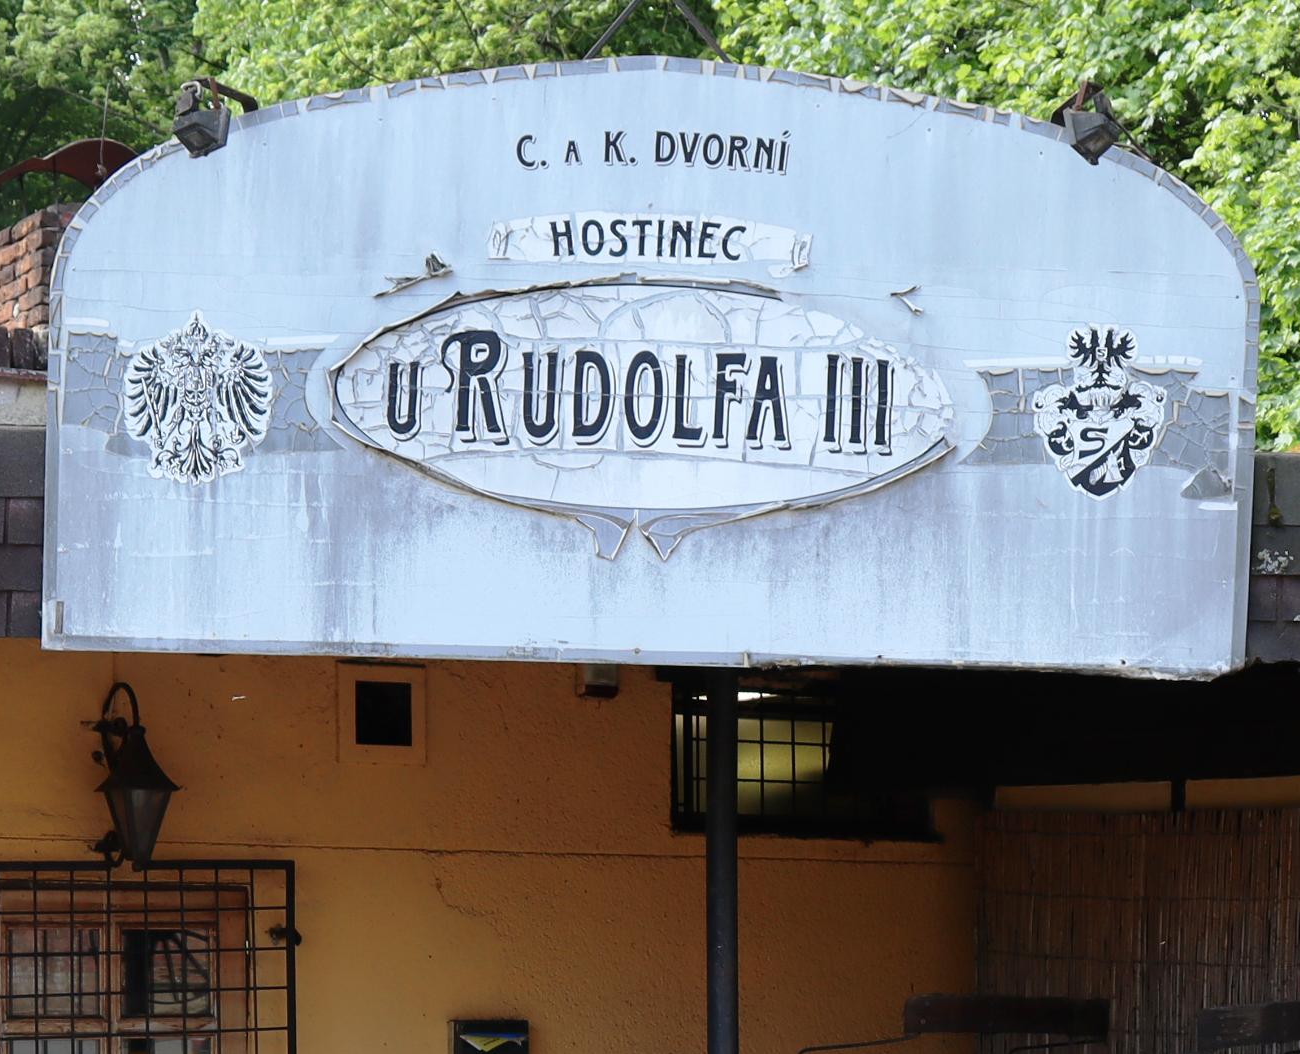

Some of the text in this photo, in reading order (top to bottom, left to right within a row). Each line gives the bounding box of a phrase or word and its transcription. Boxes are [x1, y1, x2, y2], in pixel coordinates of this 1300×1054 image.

[516, 134, 549, 170] C.
[604, 131, 638, 166] K.
[655, 130, 791, 175] DVORNÍ
[550, 218, 746, 261] HOSTINEC
[441, 330, 793, 451] RUDOLFA
[825, 353, 897, 457] III
